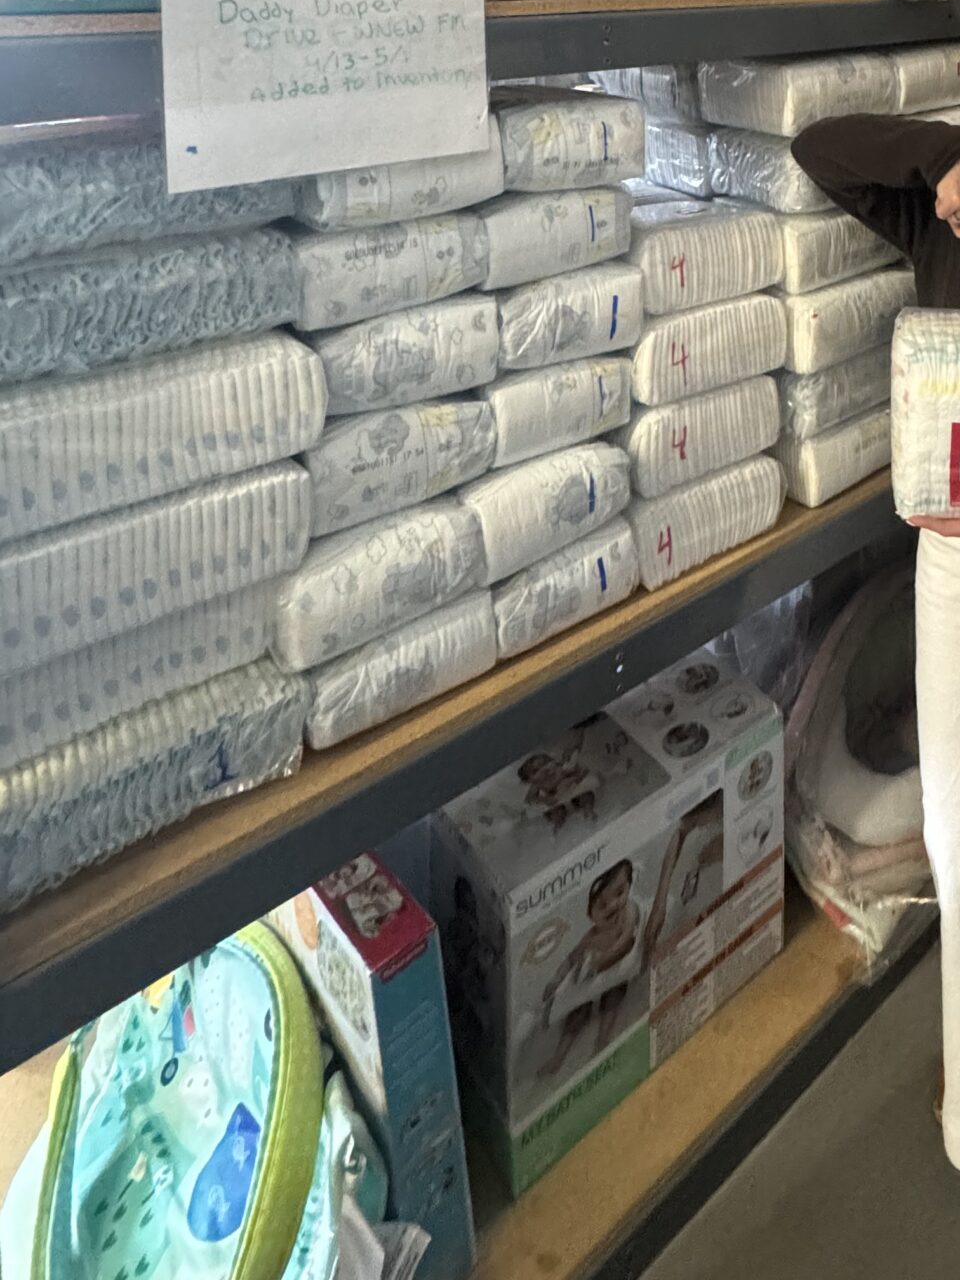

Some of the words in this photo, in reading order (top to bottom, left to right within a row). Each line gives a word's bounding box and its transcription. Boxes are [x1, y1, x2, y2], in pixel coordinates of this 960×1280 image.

[243, 28, 321, 50] Drive
[342, 76, 365, 92] to
[671, 253, 686, 289] 4
[671, 342, 689, 386] 4
[672, 425, 688, 461] 4
[657, 525, 672, 565] 4
[515, 843, 607, 919] summer
